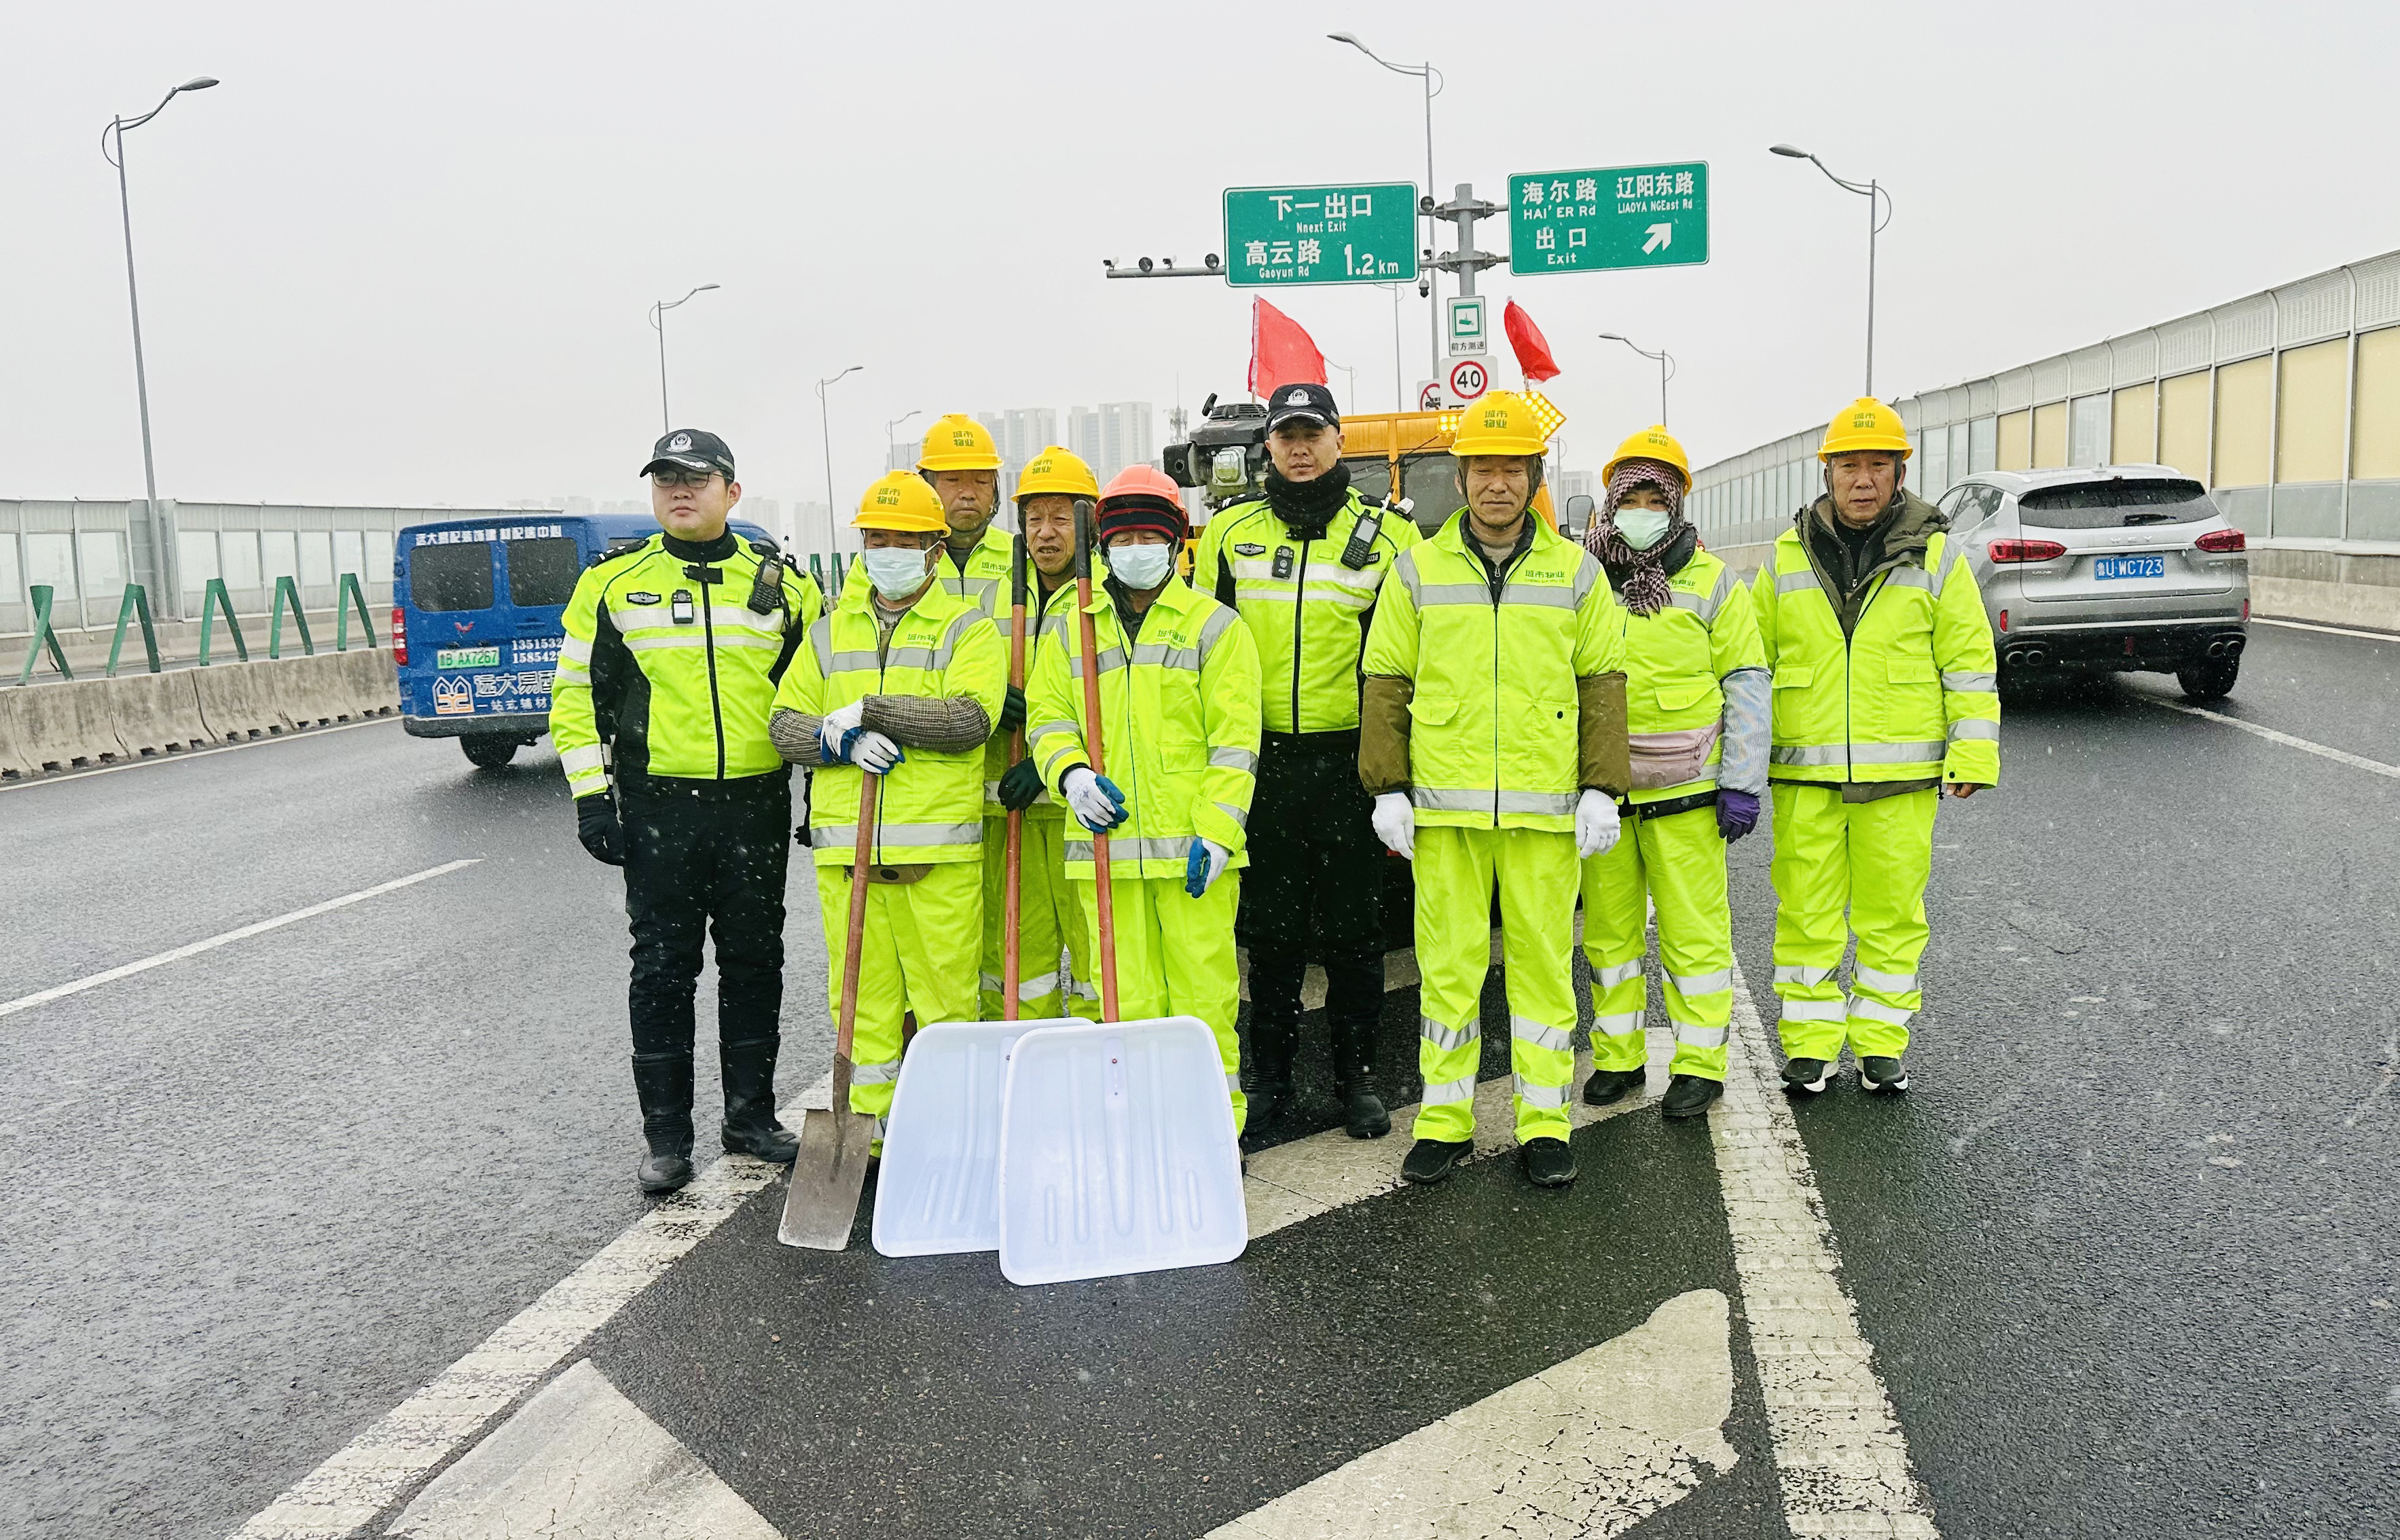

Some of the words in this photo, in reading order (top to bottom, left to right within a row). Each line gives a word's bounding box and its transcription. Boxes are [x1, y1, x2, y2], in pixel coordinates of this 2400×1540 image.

[1522, 177, 1597, 205] 海尔路
[1616, 171, 1694, 199] 辽阳东路
[1268, 192, 1372, 221] 下一出口
[1579, 204, 1596, 217] Rd
[1618, 201, 1647, 214] LIAOYA
[1650, 199, 1679, 212] NGEast
[1682, 198, 1693, 209] Rd
[1296, 221, 1324, 234] Nnext
[1328, 220, 1347, 233] Exit
[1535, 226, 1586, 250] 出口
[1244, 238, 1322, 267] 高云路
[1344, 243, 1375, 276] 1.2
[1378, 259, 1399, 274] km
[1547, 252, 1577, 265] Exit
[1258, 267, 1293, 280] Gaoyun
[1298, 265, 1309, 277] Rd
[1451, 341, 1485, 352] 前方测速
[1457, 369, 1481, 388] 40
[1485, 409, 1508, 418] 城市
[1483, 419, 1507, 428] 物业
[1525, 569, 1565, 579] 城市物业
